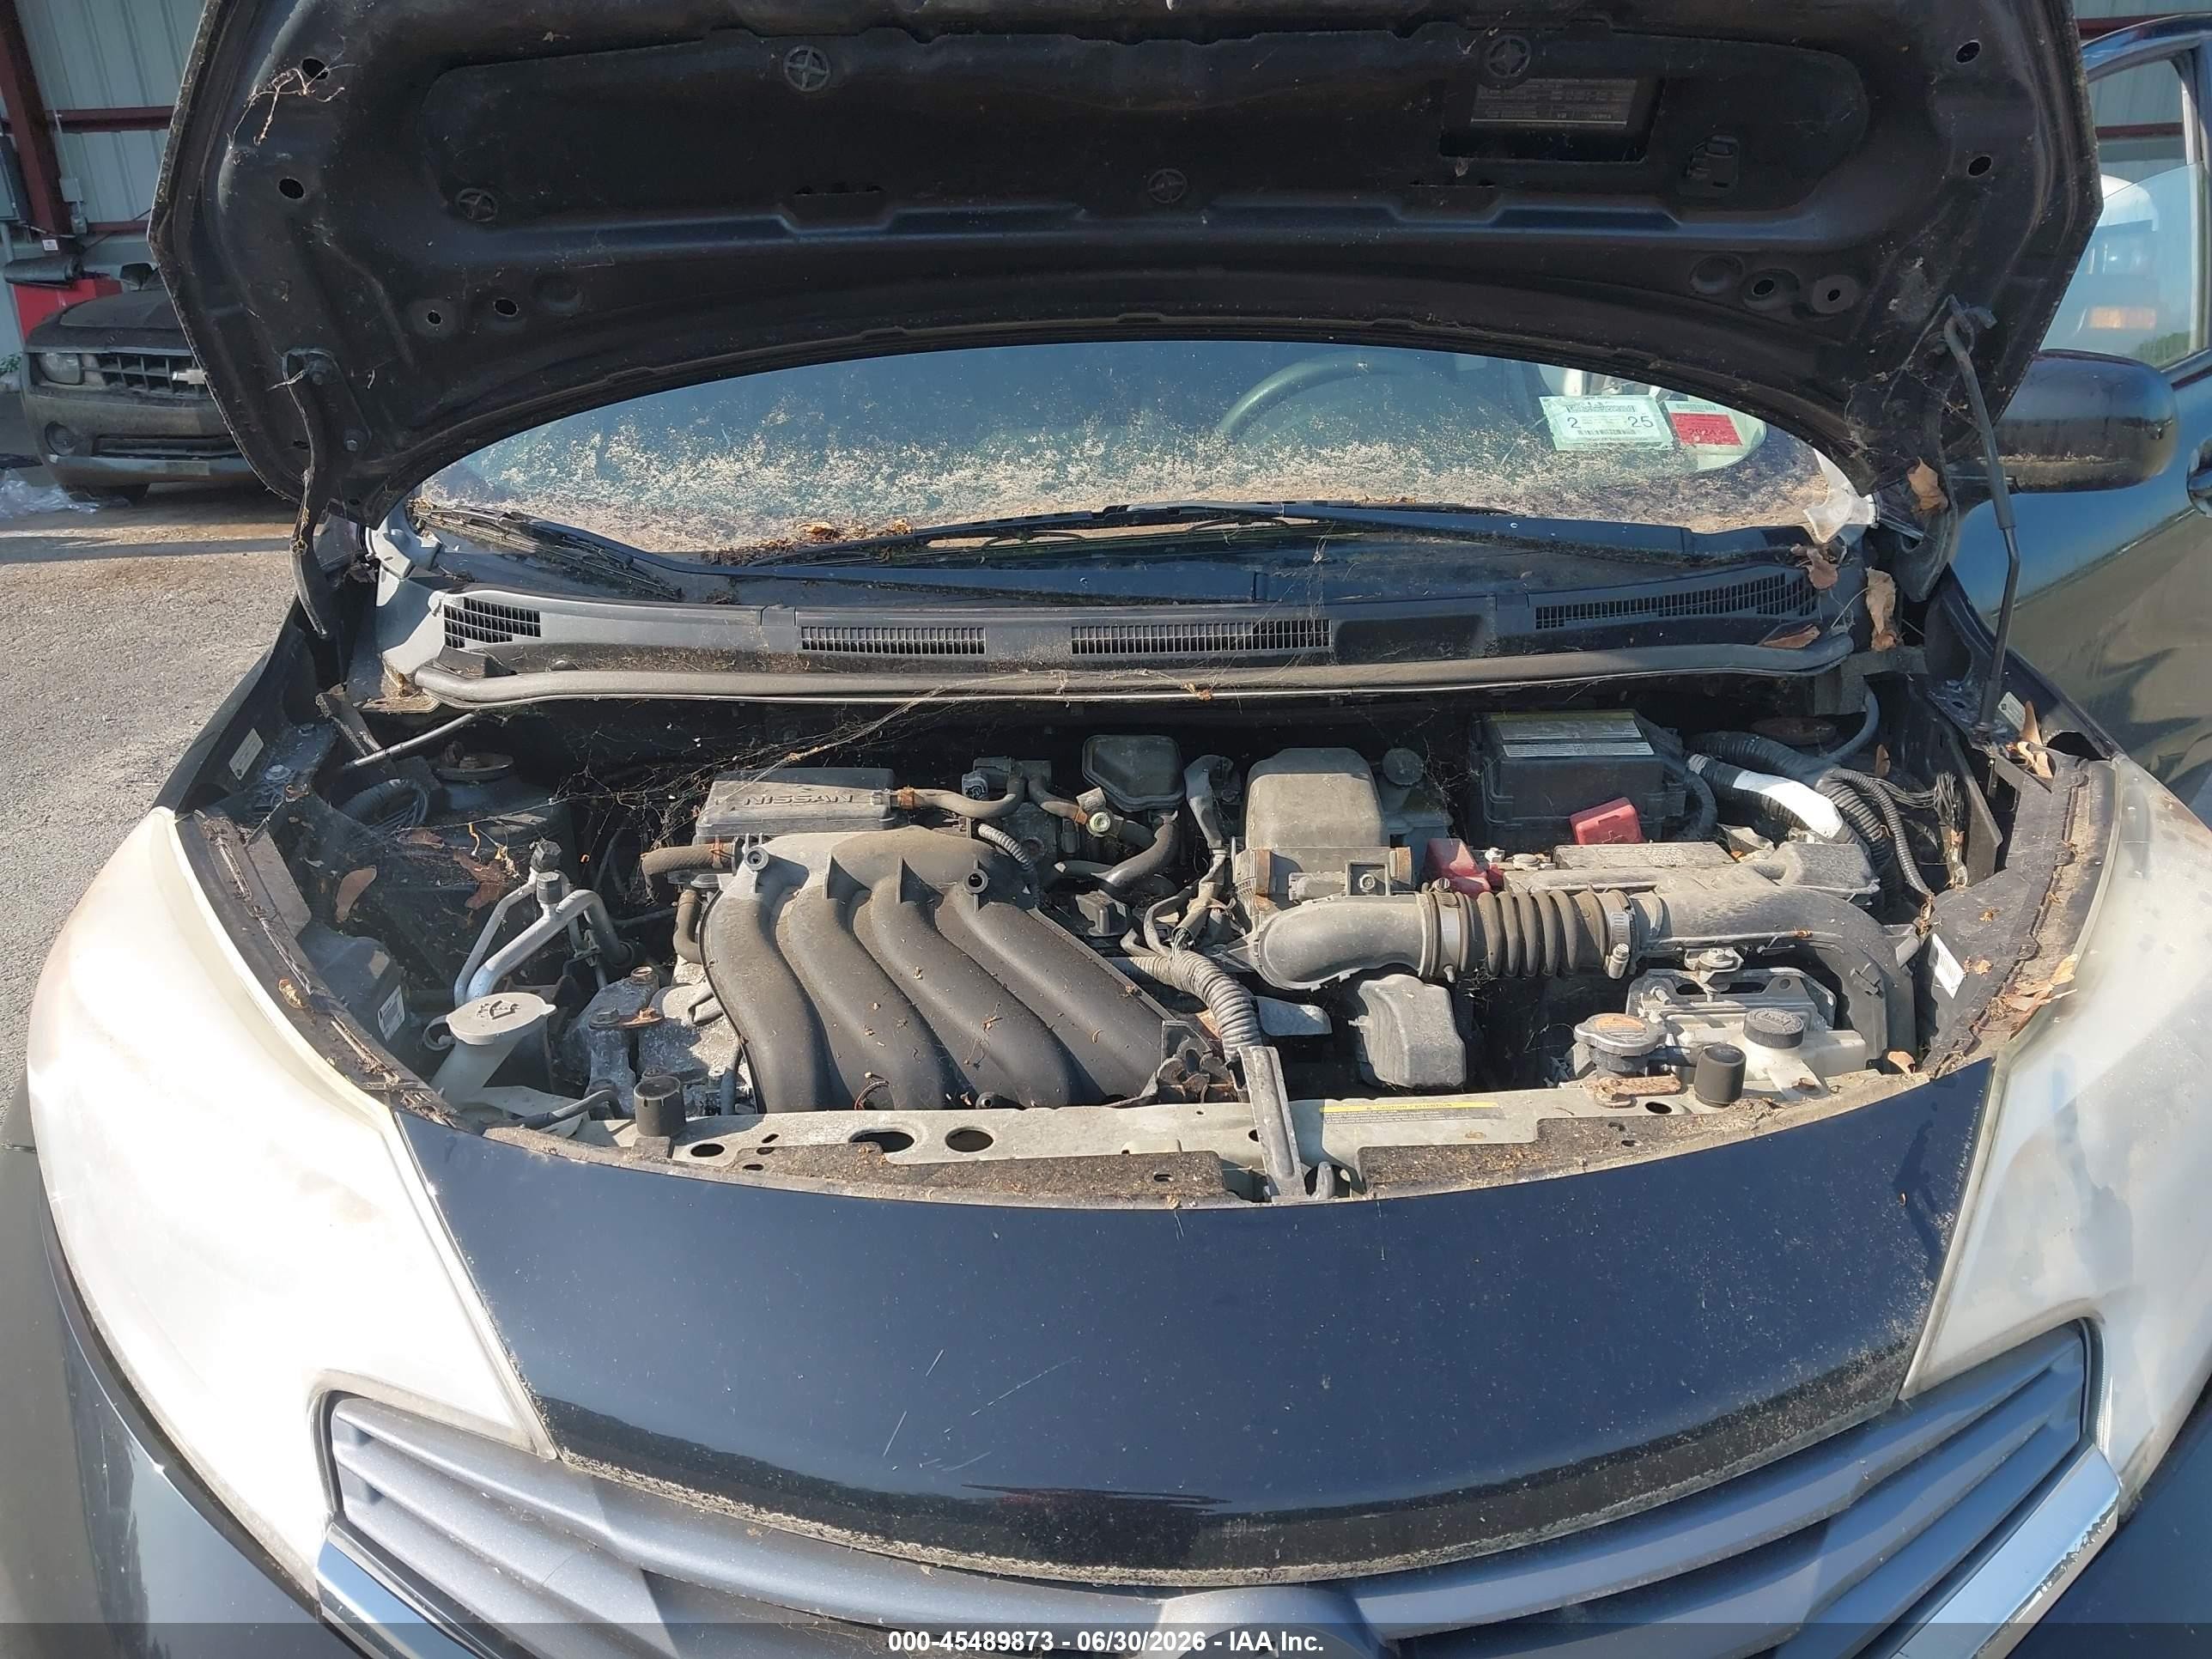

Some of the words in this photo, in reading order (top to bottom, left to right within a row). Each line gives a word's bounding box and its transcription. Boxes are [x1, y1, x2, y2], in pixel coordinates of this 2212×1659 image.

[1567, 416, 1581, 428] 2
[1627, 416, 1654, 428] 25
[744, 794, 854, 805] NISSAN
